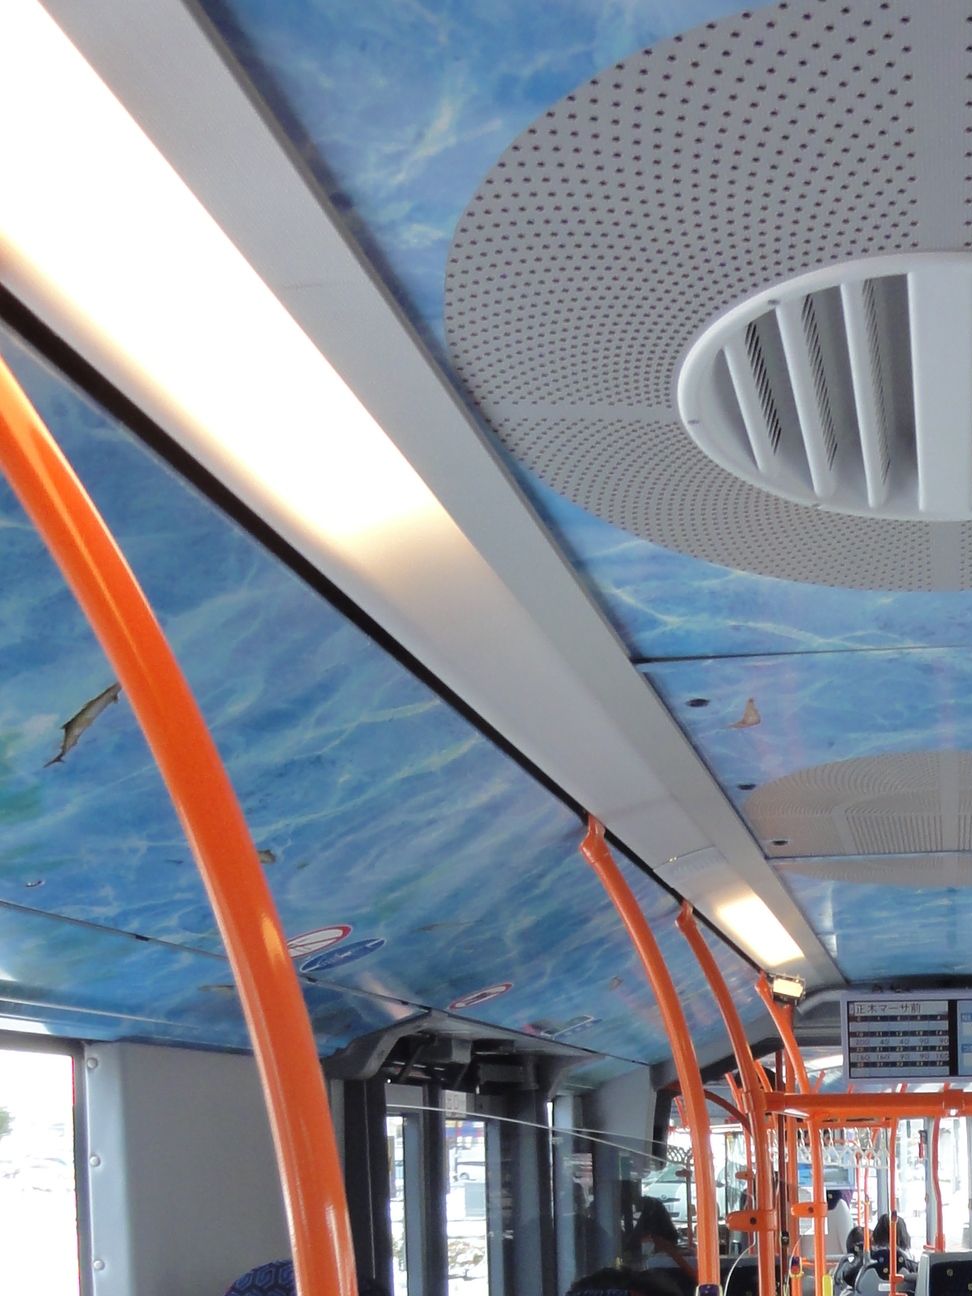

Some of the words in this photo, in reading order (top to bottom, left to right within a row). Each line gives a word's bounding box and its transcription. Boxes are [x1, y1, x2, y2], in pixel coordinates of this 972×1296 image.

[856, 1003, 921, 1014] 正木マーサ前
